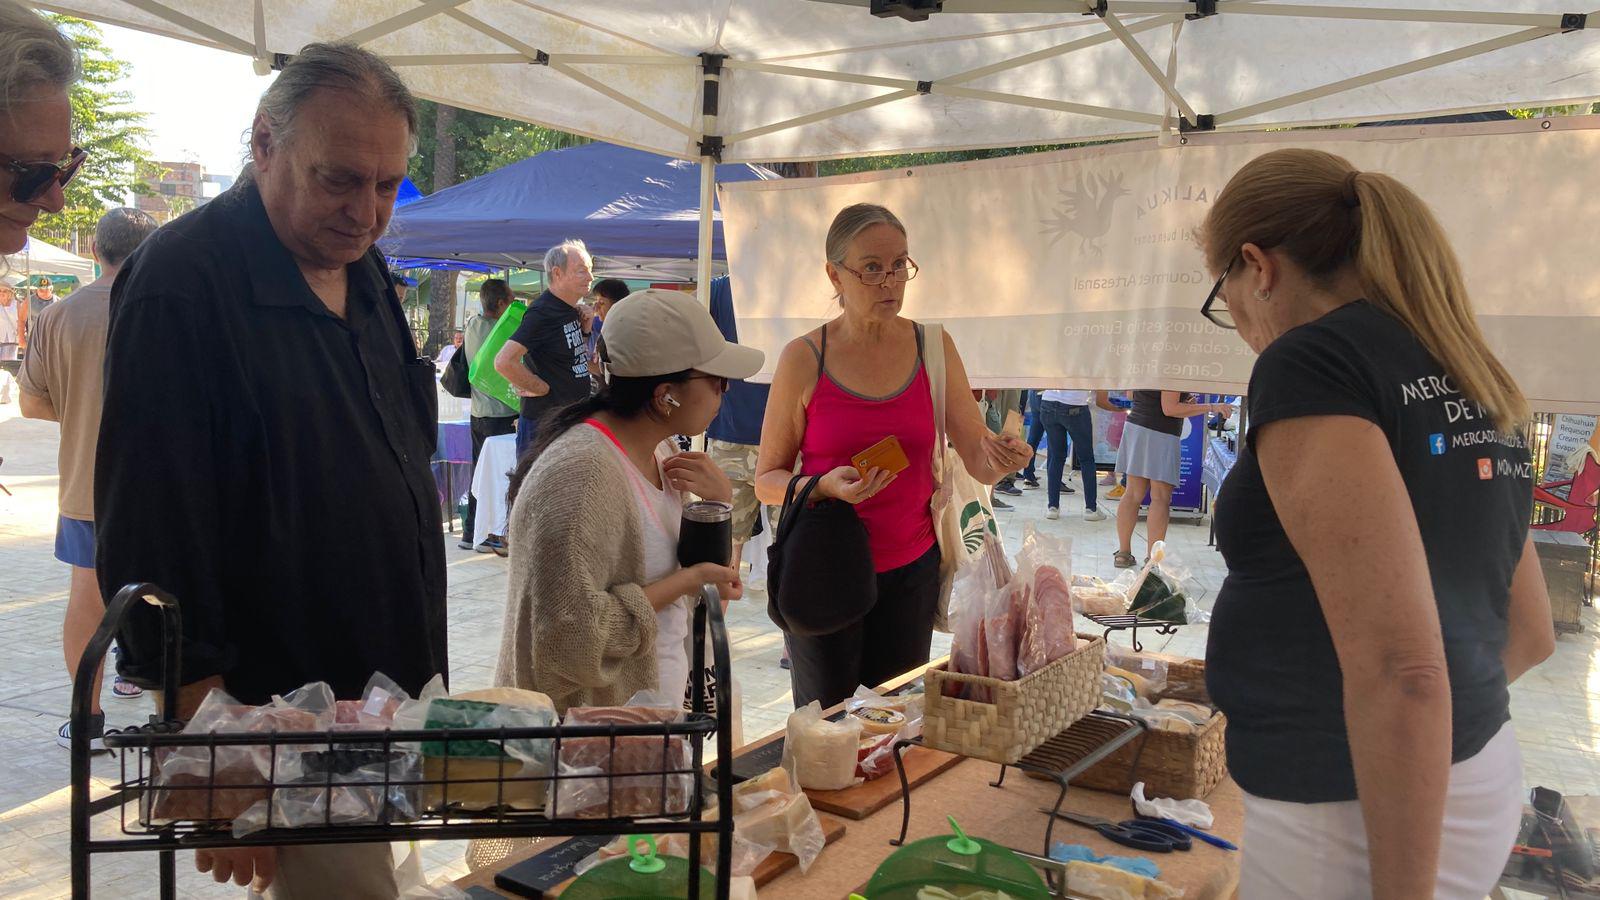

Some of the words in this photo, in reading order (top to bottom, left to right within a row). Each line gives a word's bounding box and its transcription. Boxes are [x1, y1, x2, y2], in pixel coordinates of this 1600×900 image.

[1444, 399, 1474, 423] DE
[1561, 415, 1595, 427] Chihuahua
[1452, 430, 1497, 448] MERCADO
[1558, 434, 1579, 443] Cream
[1556, 443, 1576, 453] Evapo
